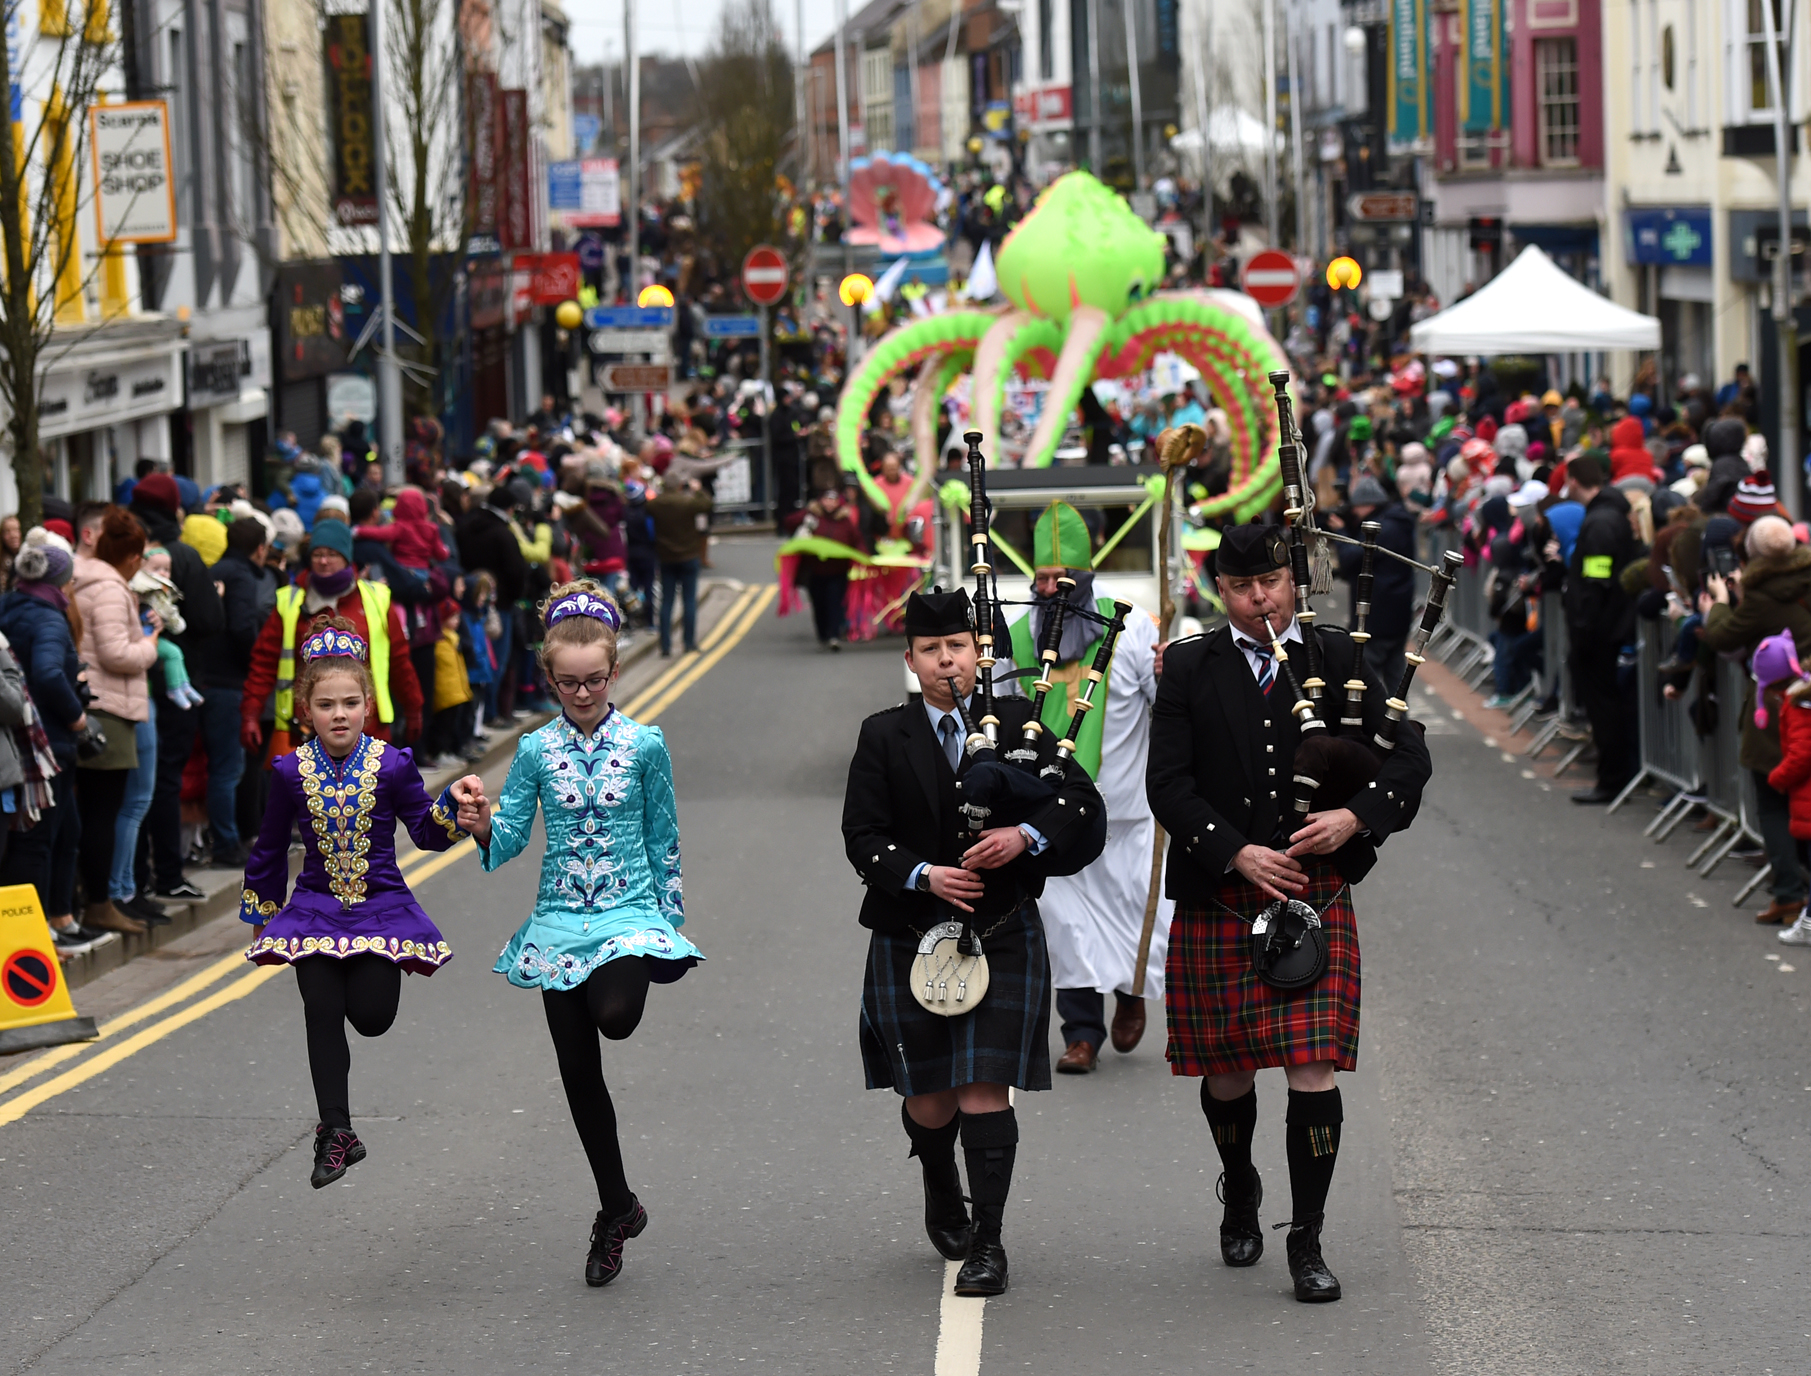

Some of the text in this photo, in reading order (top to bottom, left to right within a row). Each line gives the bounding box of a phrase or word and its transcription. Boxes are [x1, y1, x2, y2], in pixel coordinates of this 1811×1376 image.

[100, 149, 161, 171] SHOE
[102, 173, 164, 195] SHOP
[1, 905, 34, 918] POLICE
